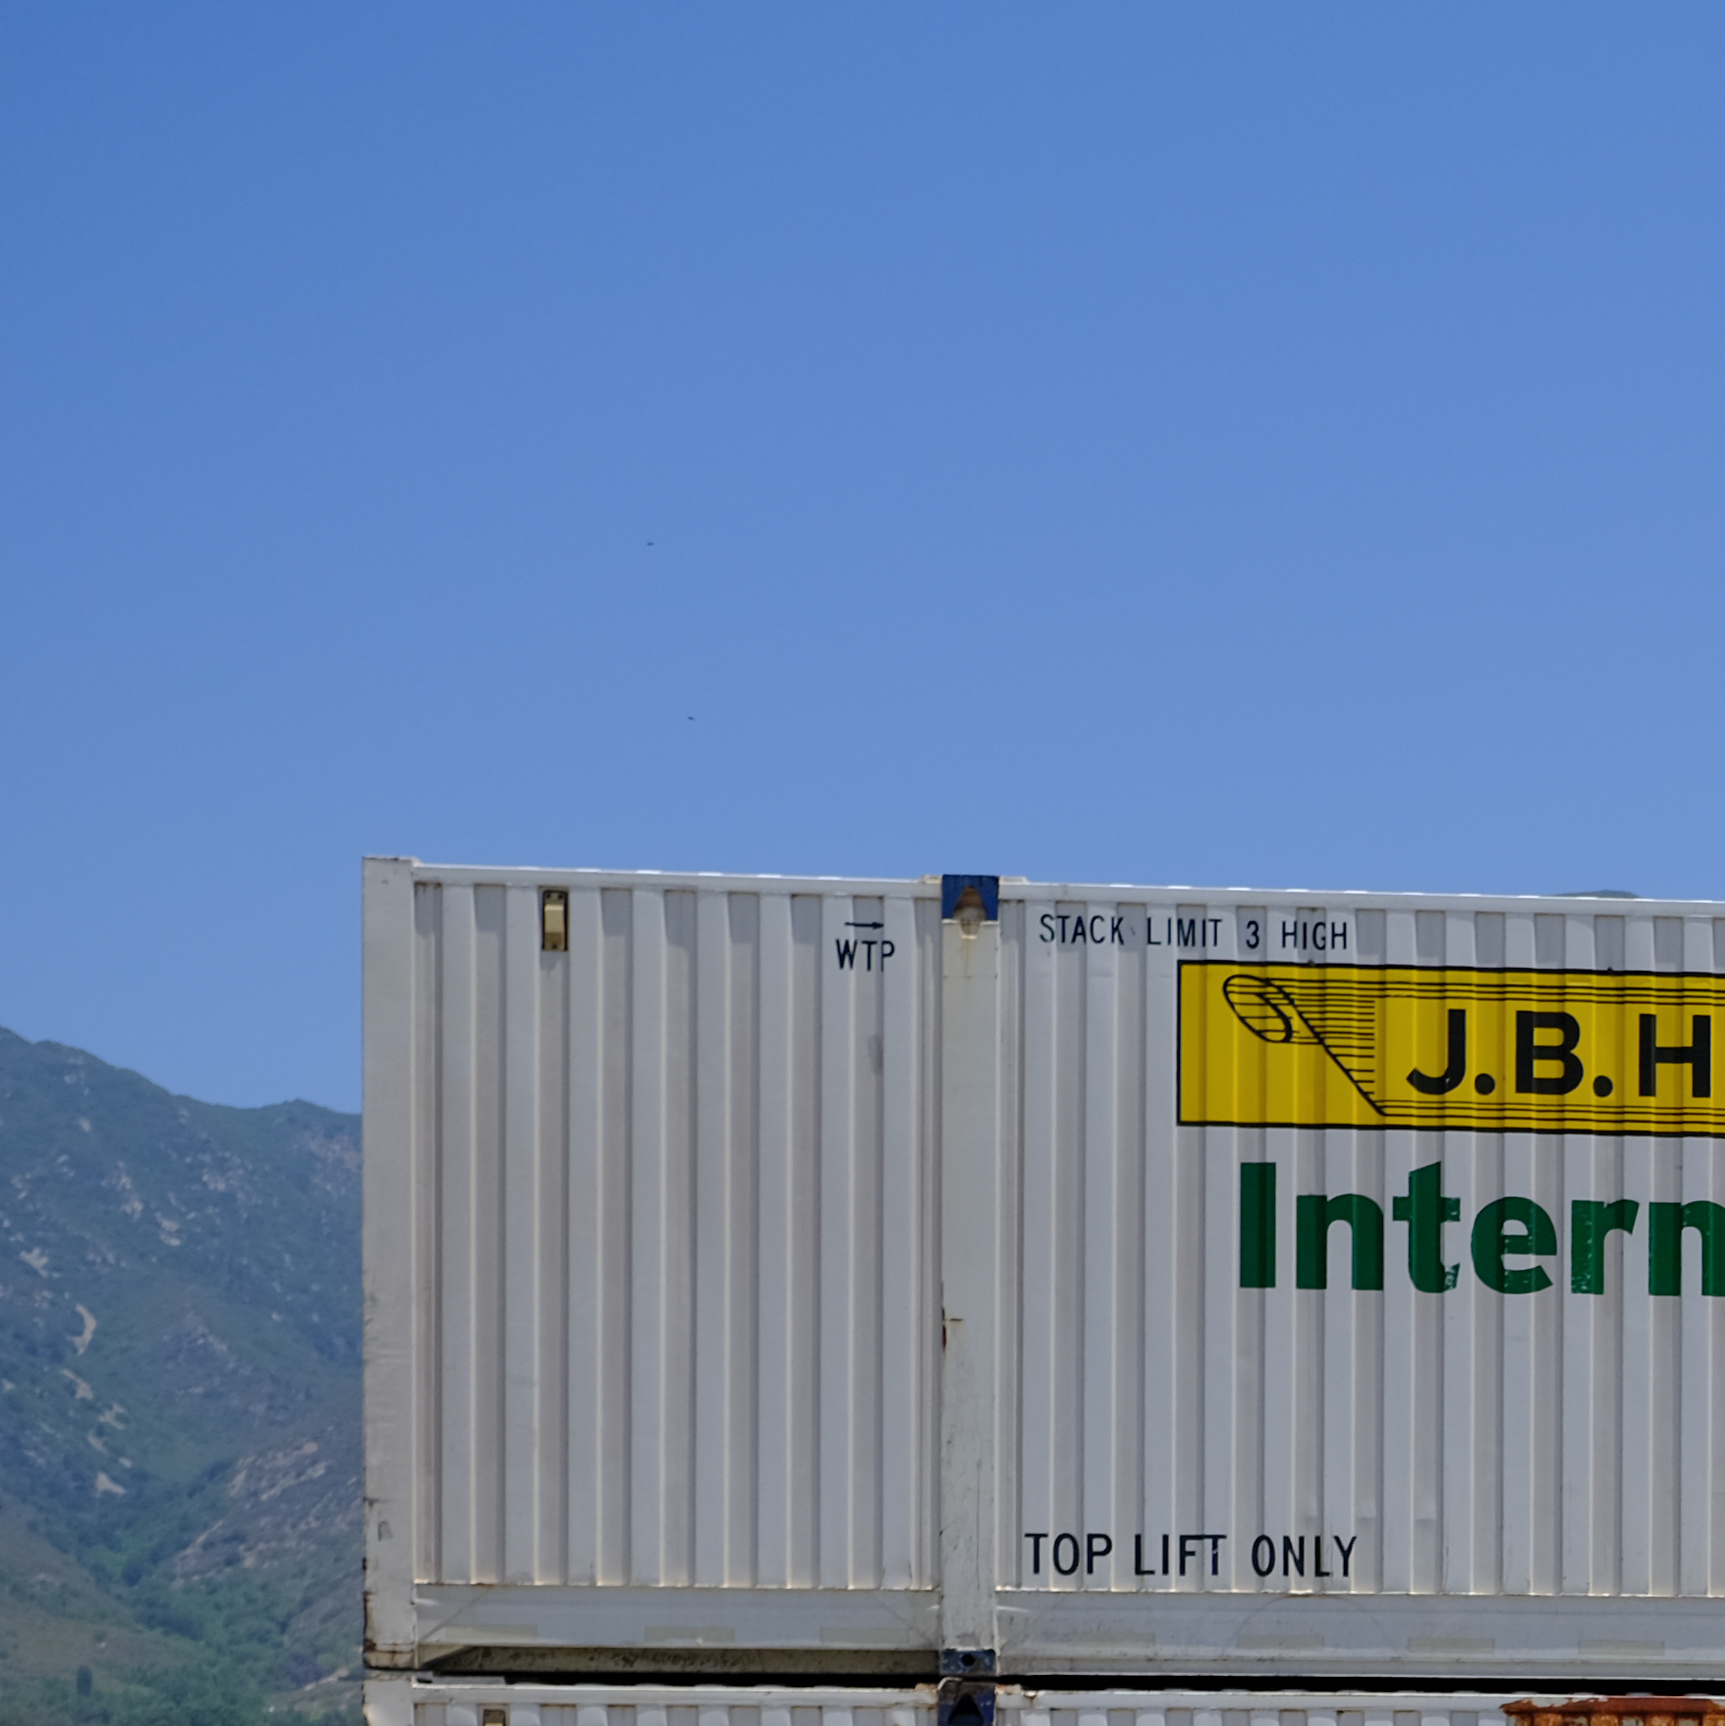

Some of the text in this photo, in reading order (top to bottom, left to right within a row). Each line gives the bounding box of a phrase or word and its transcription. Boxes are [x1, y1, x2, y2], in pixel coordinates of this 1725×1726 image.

[1039, 914, 1348, 950] STACK LIMIT 3 HIGH
[836, 938, 896, 972] WTP
[1024, 1533, 1358, 1578] TOP LIFT ONLY
